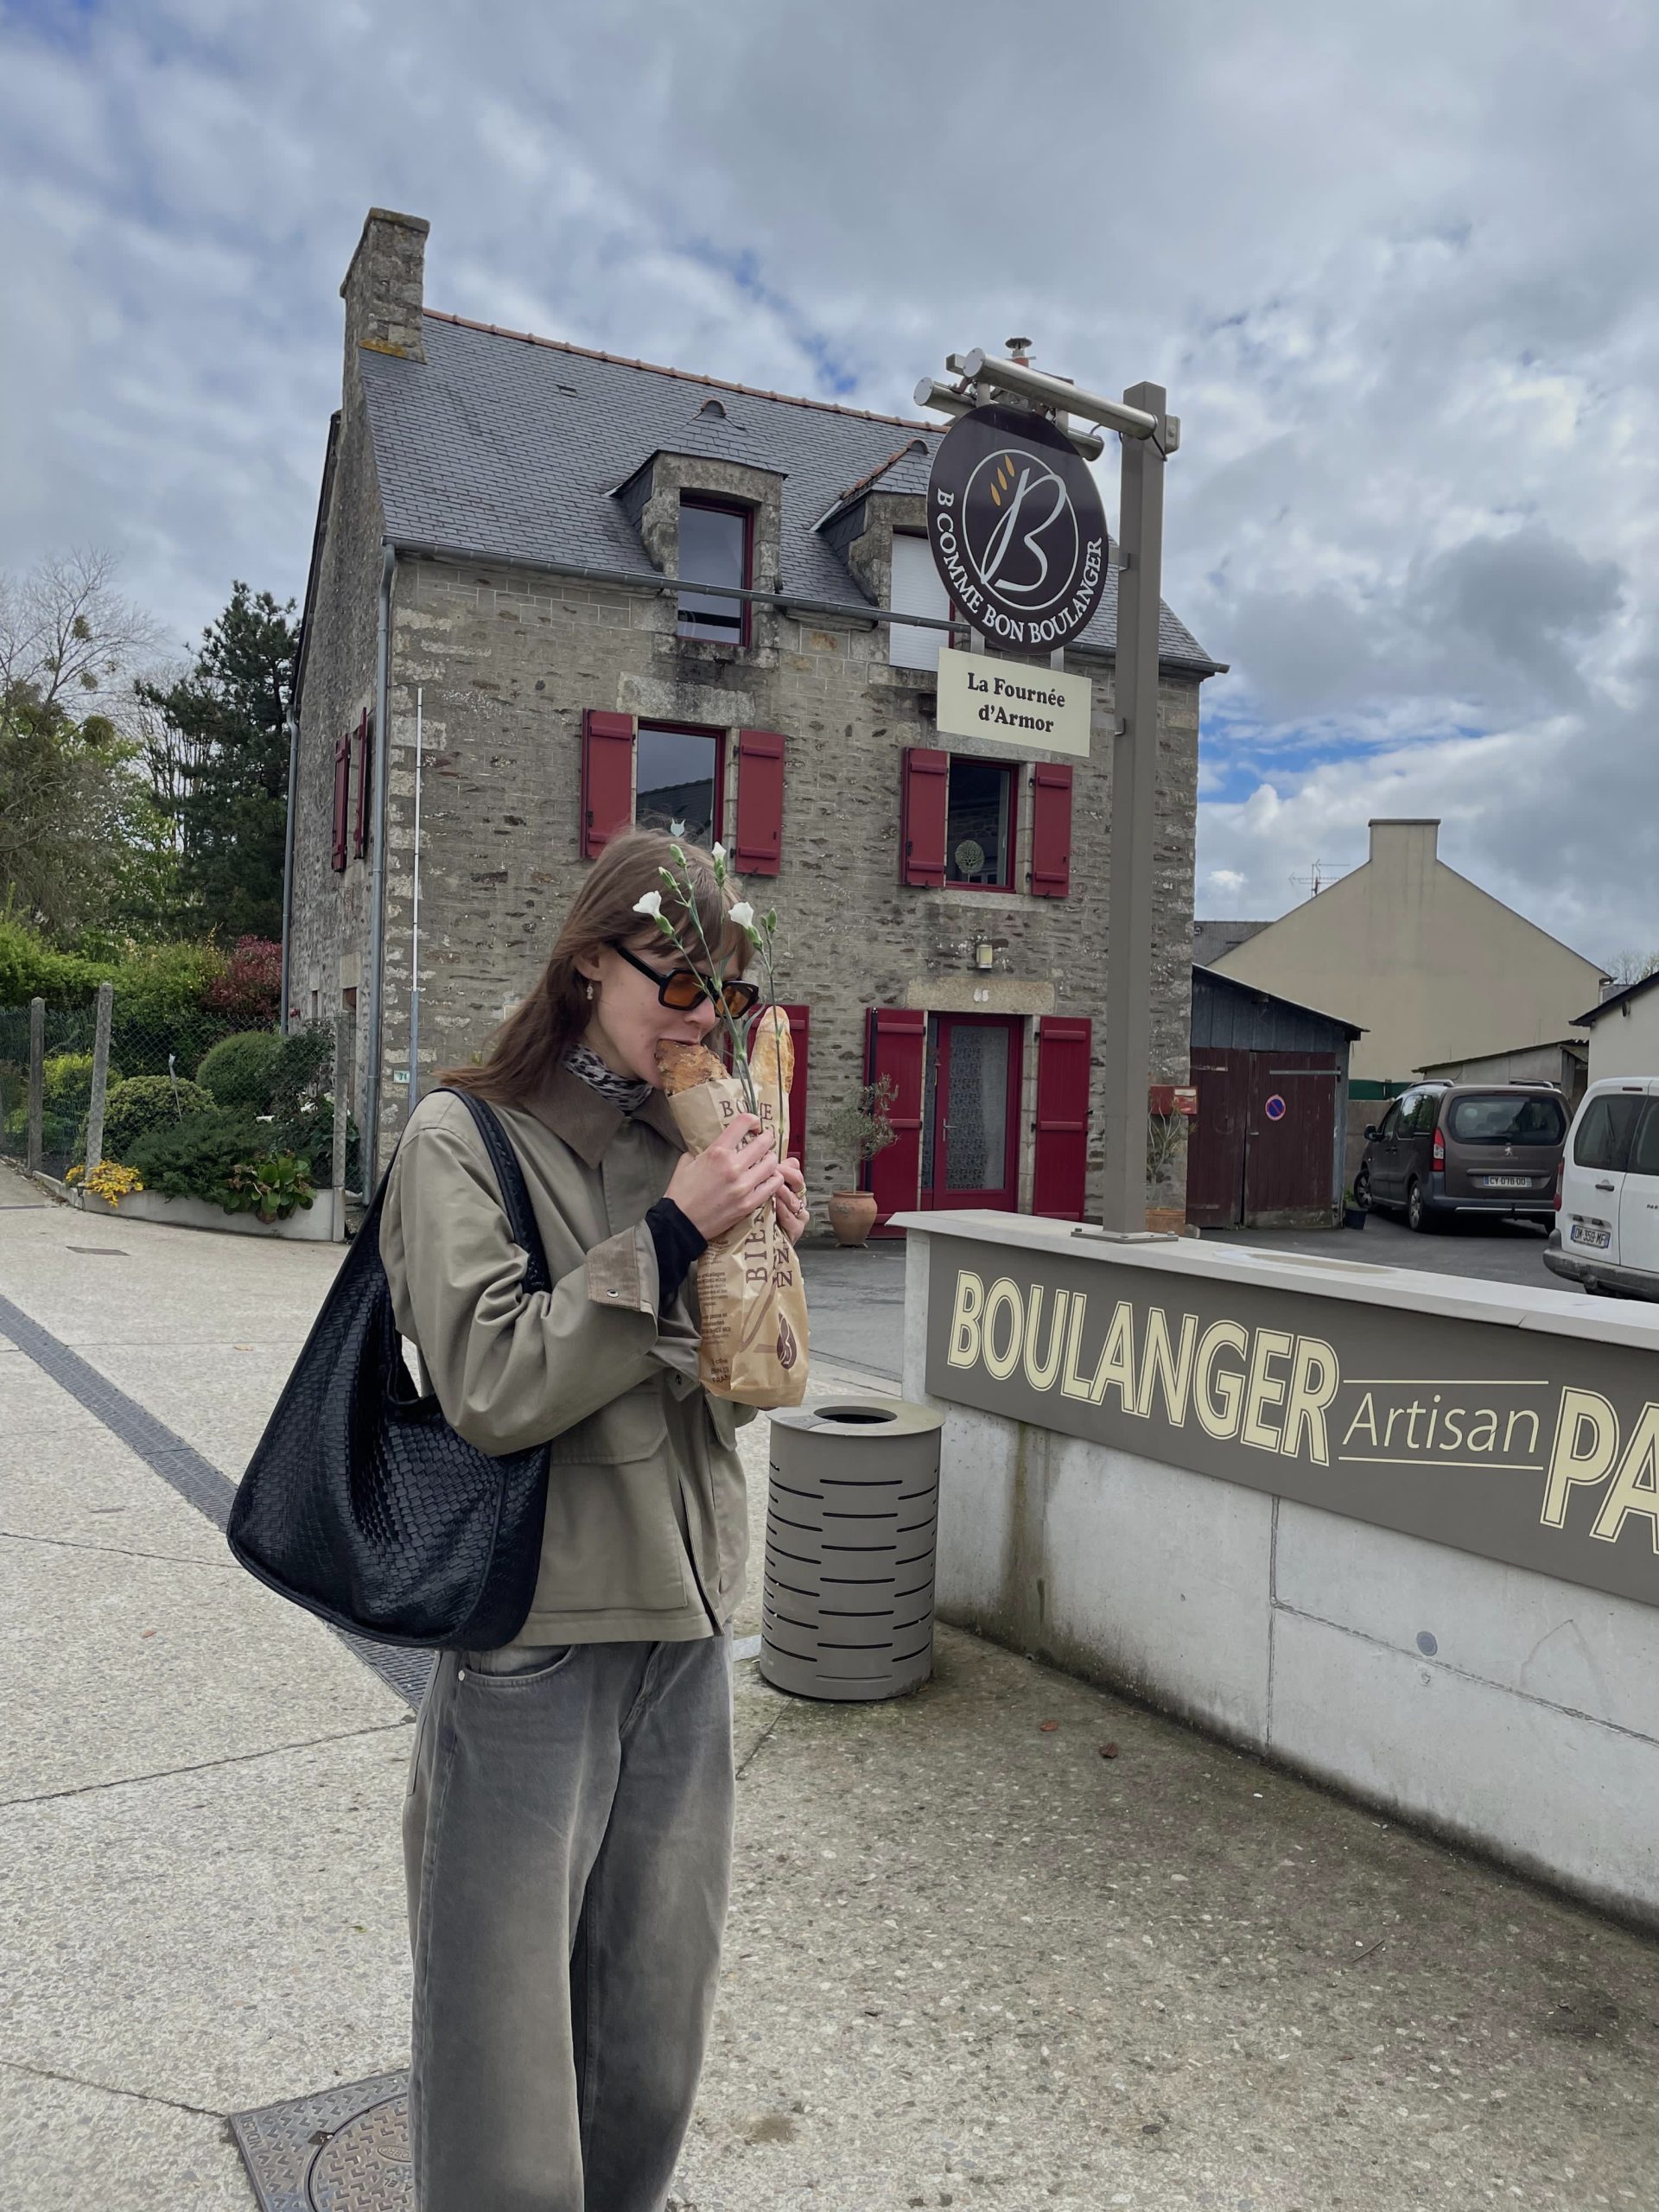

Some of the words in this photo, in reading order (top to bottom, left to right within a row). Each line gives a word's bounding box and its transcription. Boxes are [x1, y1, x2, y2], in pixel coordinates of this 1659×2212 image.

[937, 488, 955, 507] B
[937, 512, 984, 613] COMME
[1028, 537, 1103, 643] BOULANGER
[982, 604, 1025, 642] BON
[968, 672, 988, 692] La
[994, 677, 1065, 707] Fournée
[978, 704, 1054, 732] d’Armor
[947, 1270, 1339, 1467] BOULANGER
[1342, 1392, 1540, 1453] Artisan
[1540, 1386, 1659, 1555] PA
